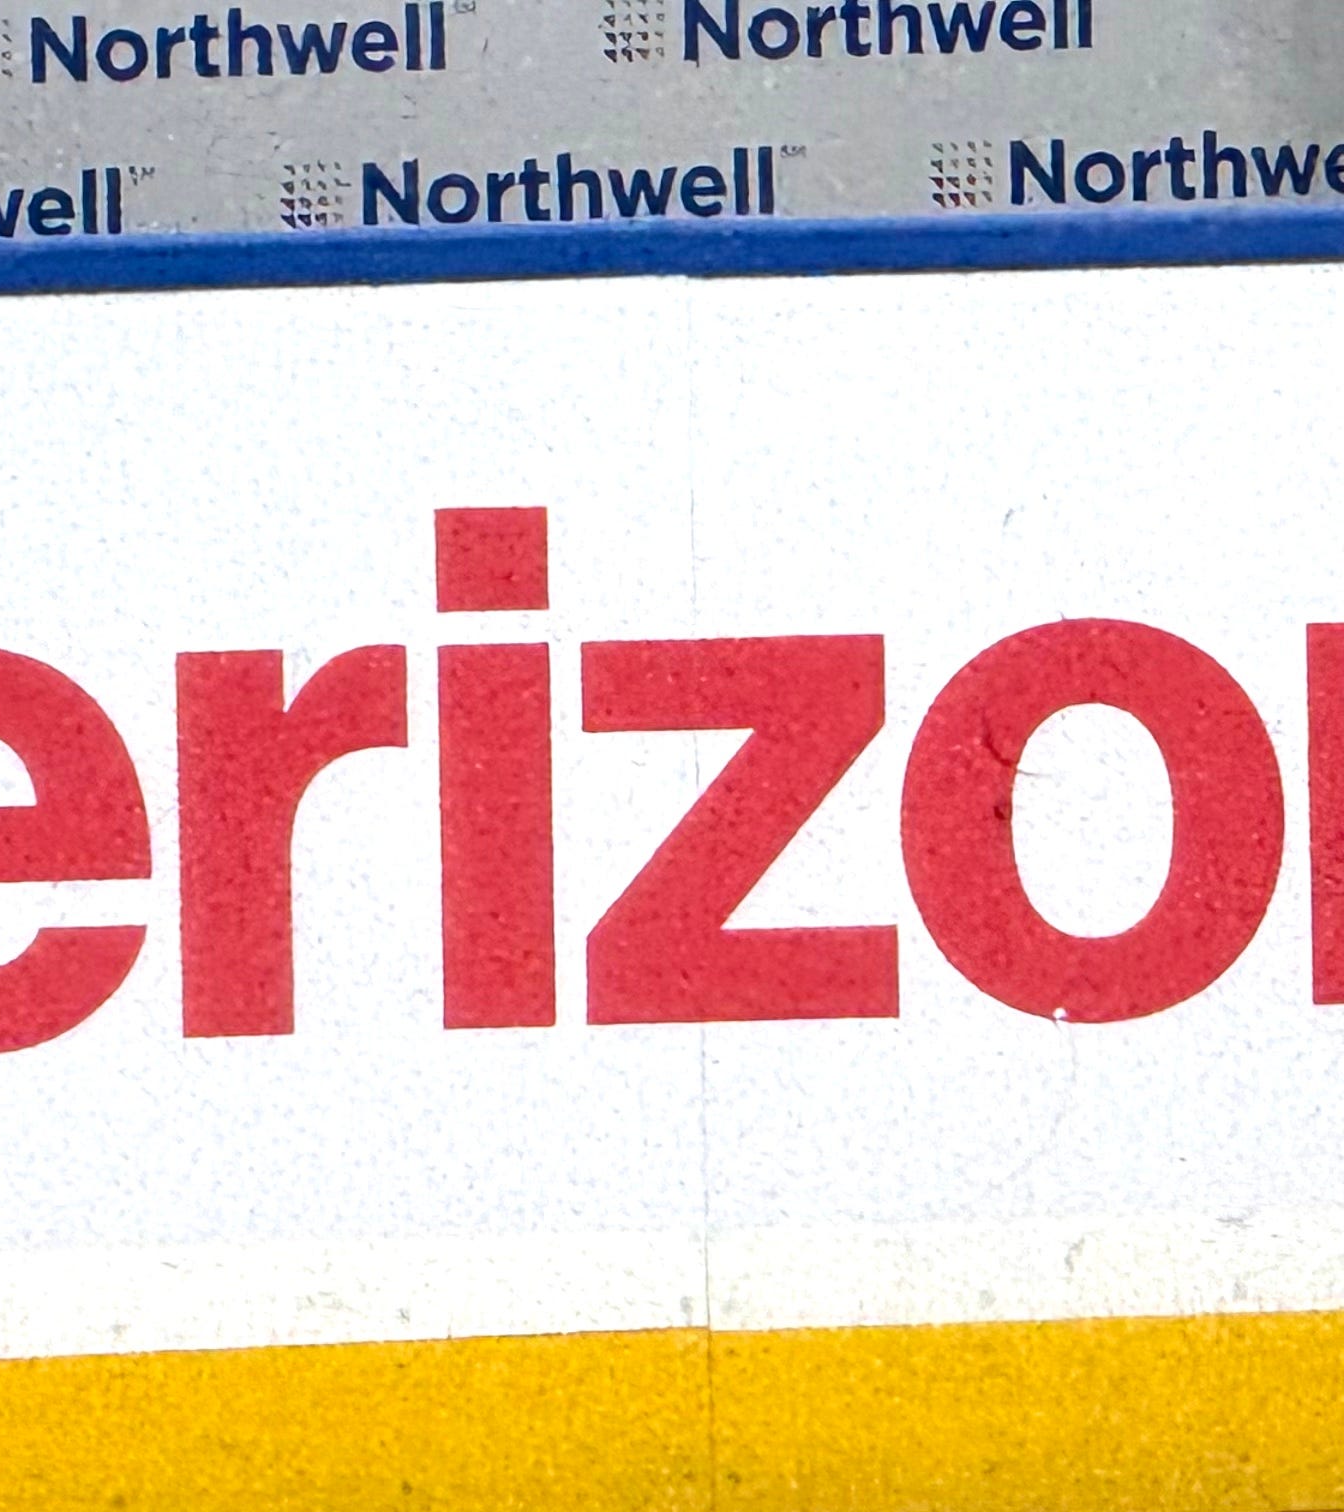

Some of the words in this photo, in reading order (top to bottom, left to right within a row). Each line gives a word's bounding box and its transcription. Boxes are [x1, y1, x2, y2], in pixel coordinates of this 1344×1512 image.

[30, 1, 447, 84] Northwell
[683, 0, 1093, 62] Northwell
[362, 145, 774, 226] Northwell
